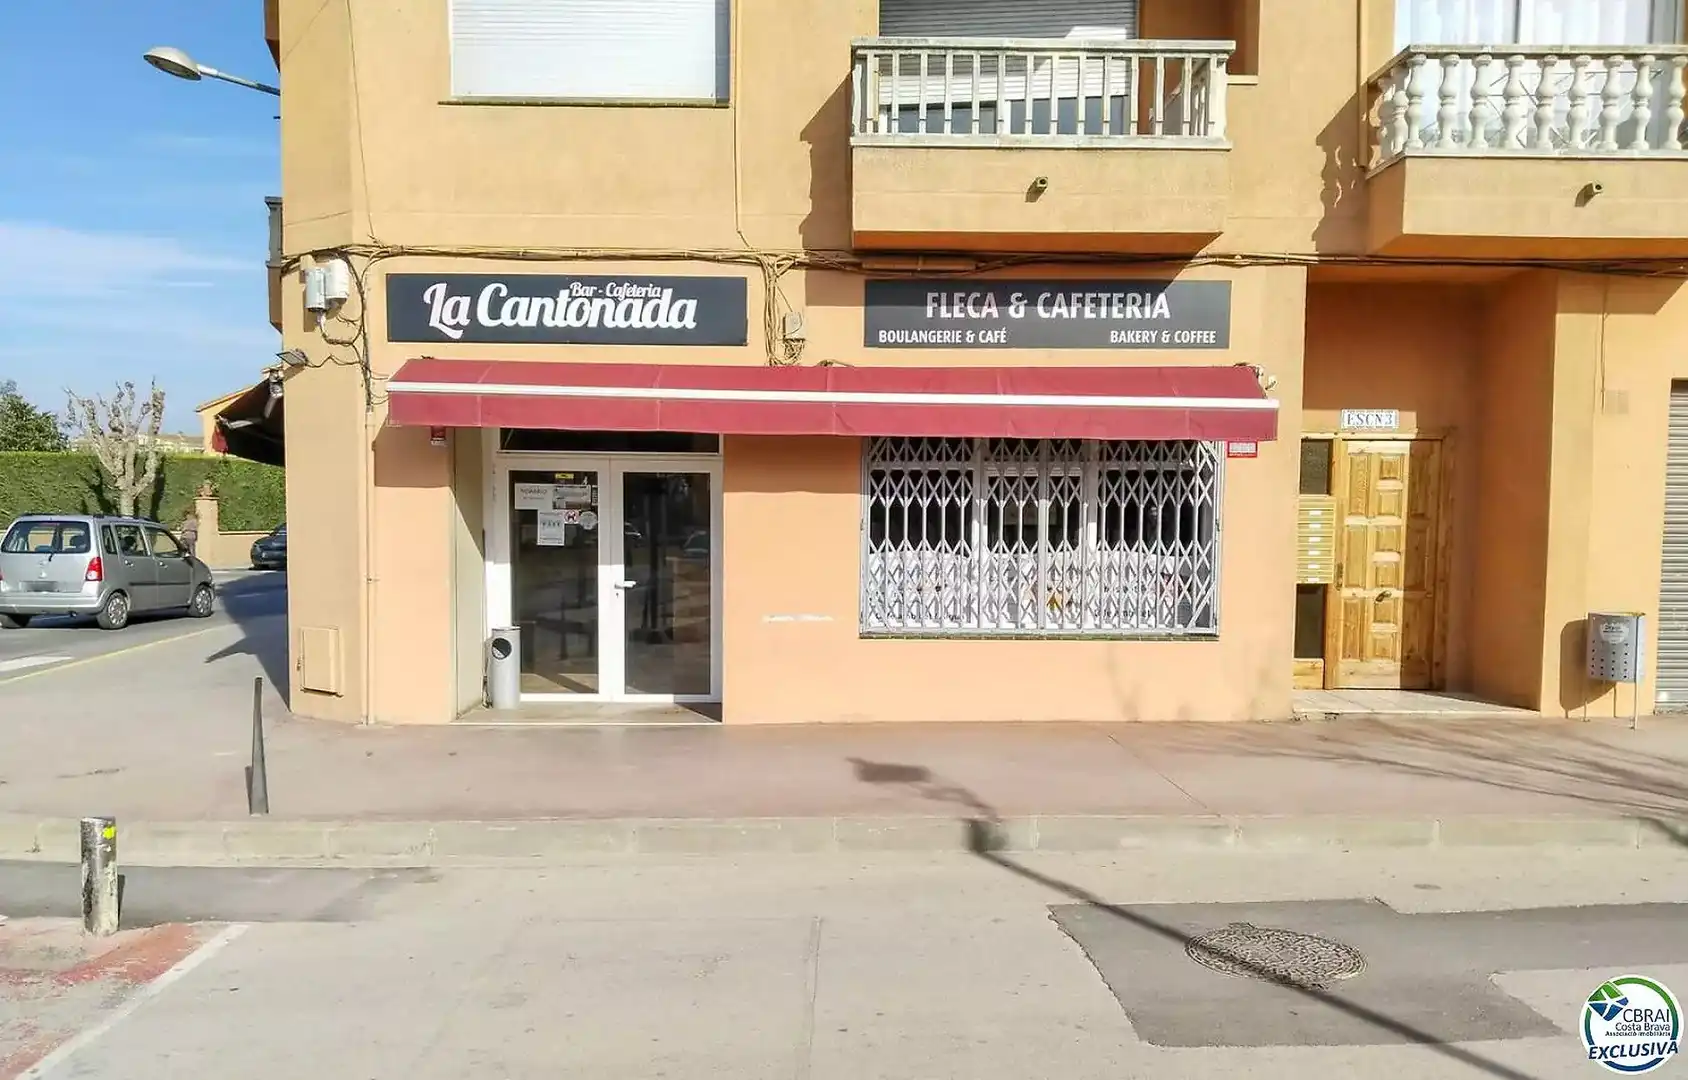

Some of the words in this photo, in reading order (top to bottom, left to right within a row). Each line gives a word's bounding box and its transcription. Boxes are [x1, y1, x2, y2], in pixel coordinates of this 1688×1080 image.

[570, 282, 597, 297] Bar
[605, 281, 662, 301] Cafeteria
[423, 283, 471, 339] La
[477, 283, 697, 329] Cantonada
[926, 292, 999, 318] FLECA
[1008, 292, 1028, 319] &
[1037, 292, 1171, 319] CAFETERIA
[878, 330, 962, 343] BOULANGERIE
[965, 330, 975, 343] &
[978, 327, 1007, 343] CAFÉ
[1110, 331, 1158, 343] BAKERY
[1161, 331, 1171, 343] &
[1174, 331, 1216, 343] COFFEE
